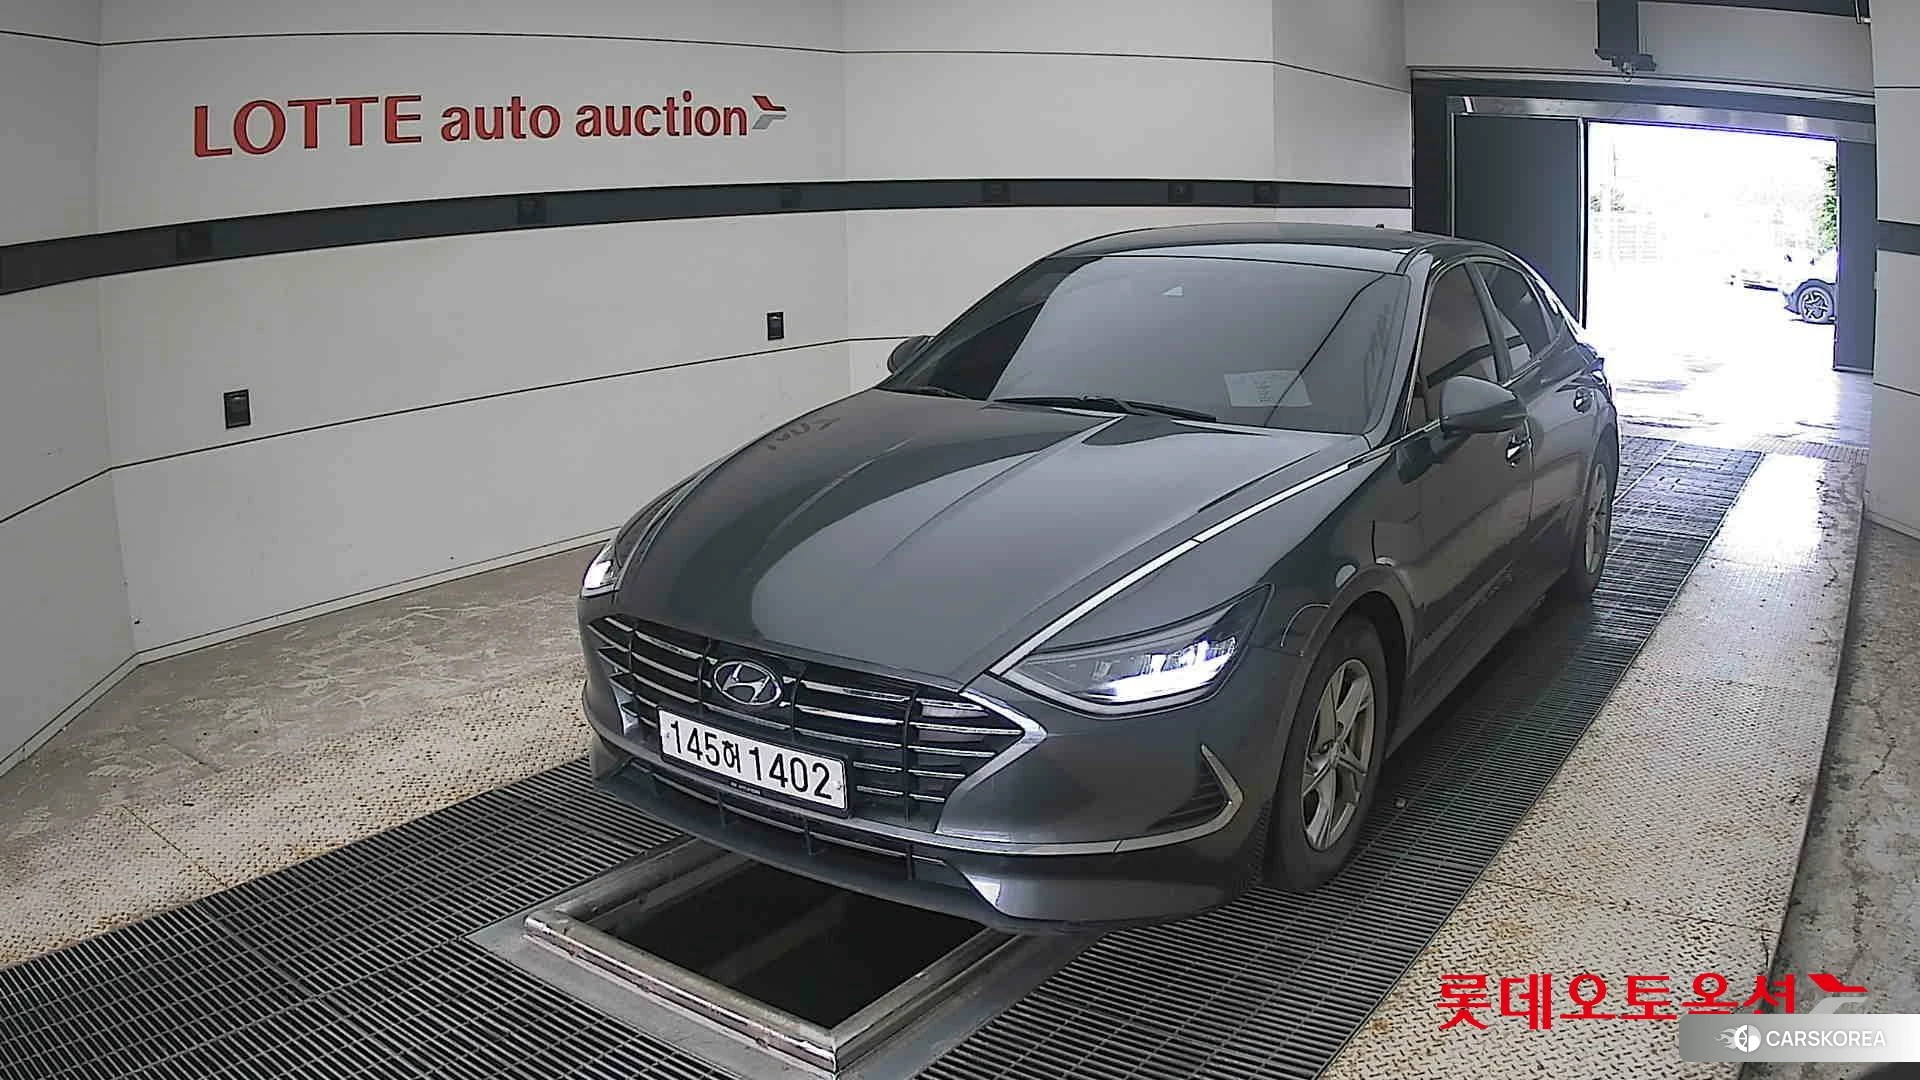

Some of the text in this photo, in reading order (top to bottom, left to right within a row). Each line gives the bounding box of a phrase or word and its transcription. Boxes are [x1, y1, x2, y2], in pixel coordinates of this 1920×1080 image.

[194, 90, 748, 158] LOTTE auto auction
